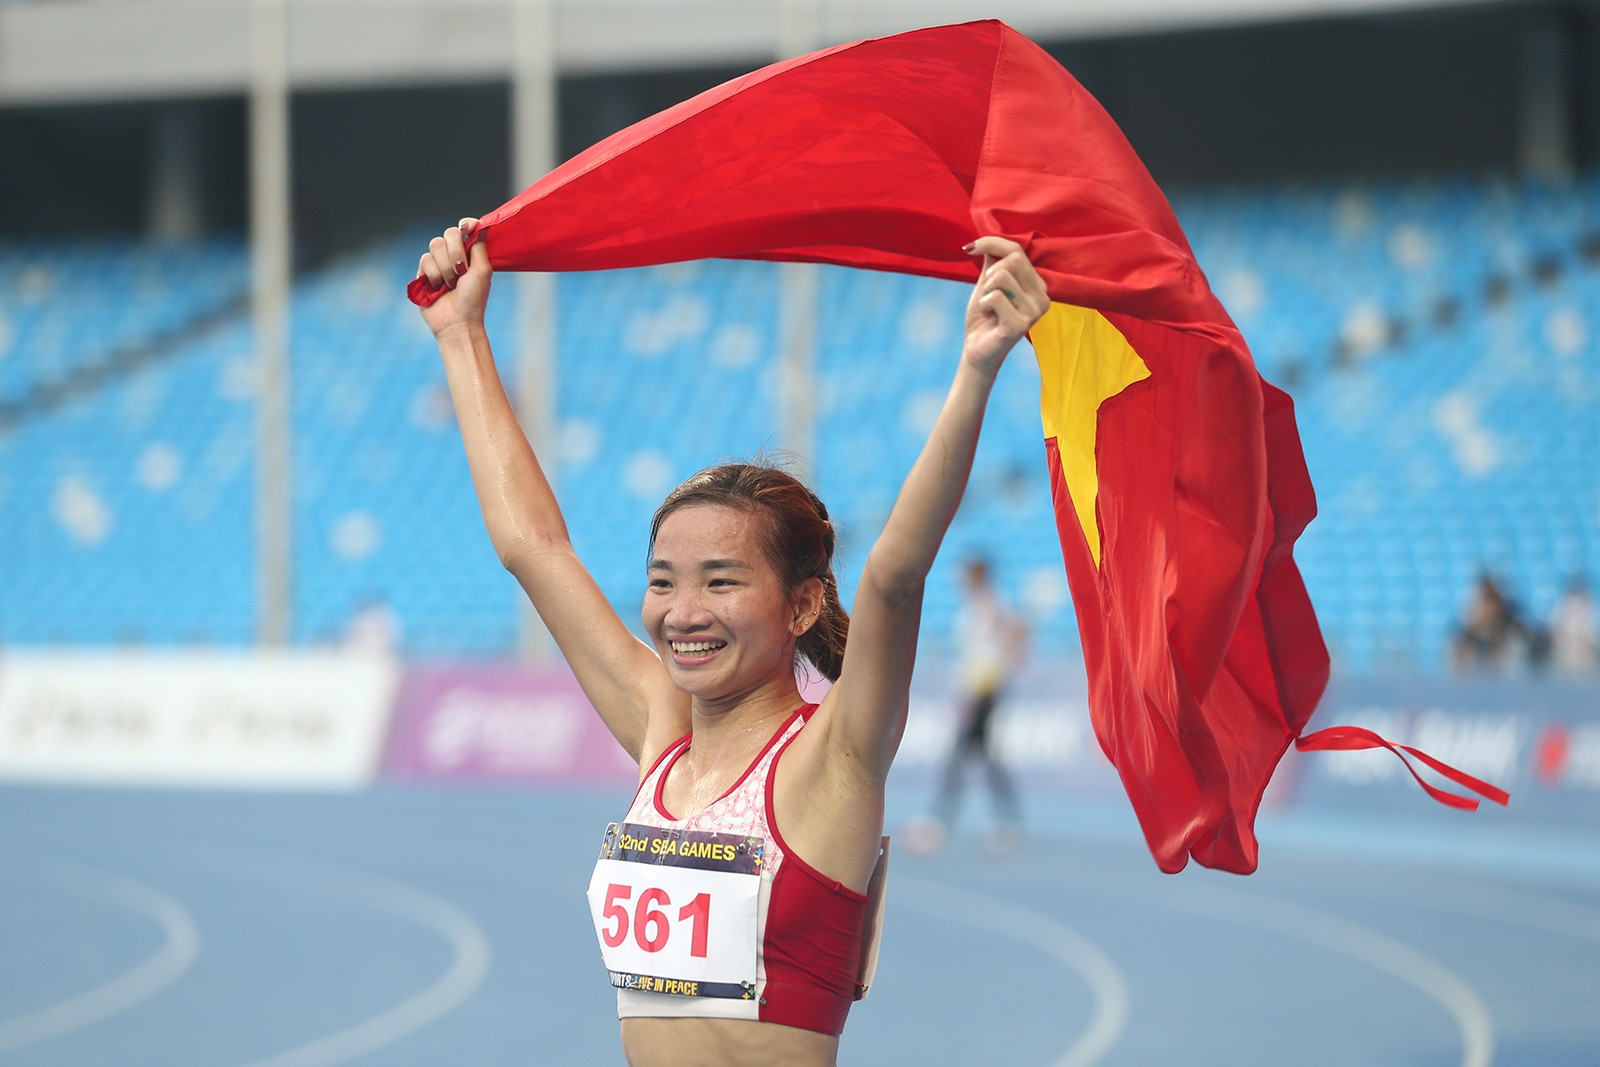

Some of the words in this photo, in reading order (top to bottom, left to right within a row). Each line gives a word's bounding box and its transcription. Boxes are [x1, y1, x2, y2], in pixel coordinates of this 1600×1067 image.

[619, 834, 648, 852] 32nd
[650, 838, 677, 855] SEA
[679, 841, 736, 861] GAMES
[601, 883, 711, 958] 561
[653, 978, 664, 992] IN
[665, 980, 698, 996] PEACE
